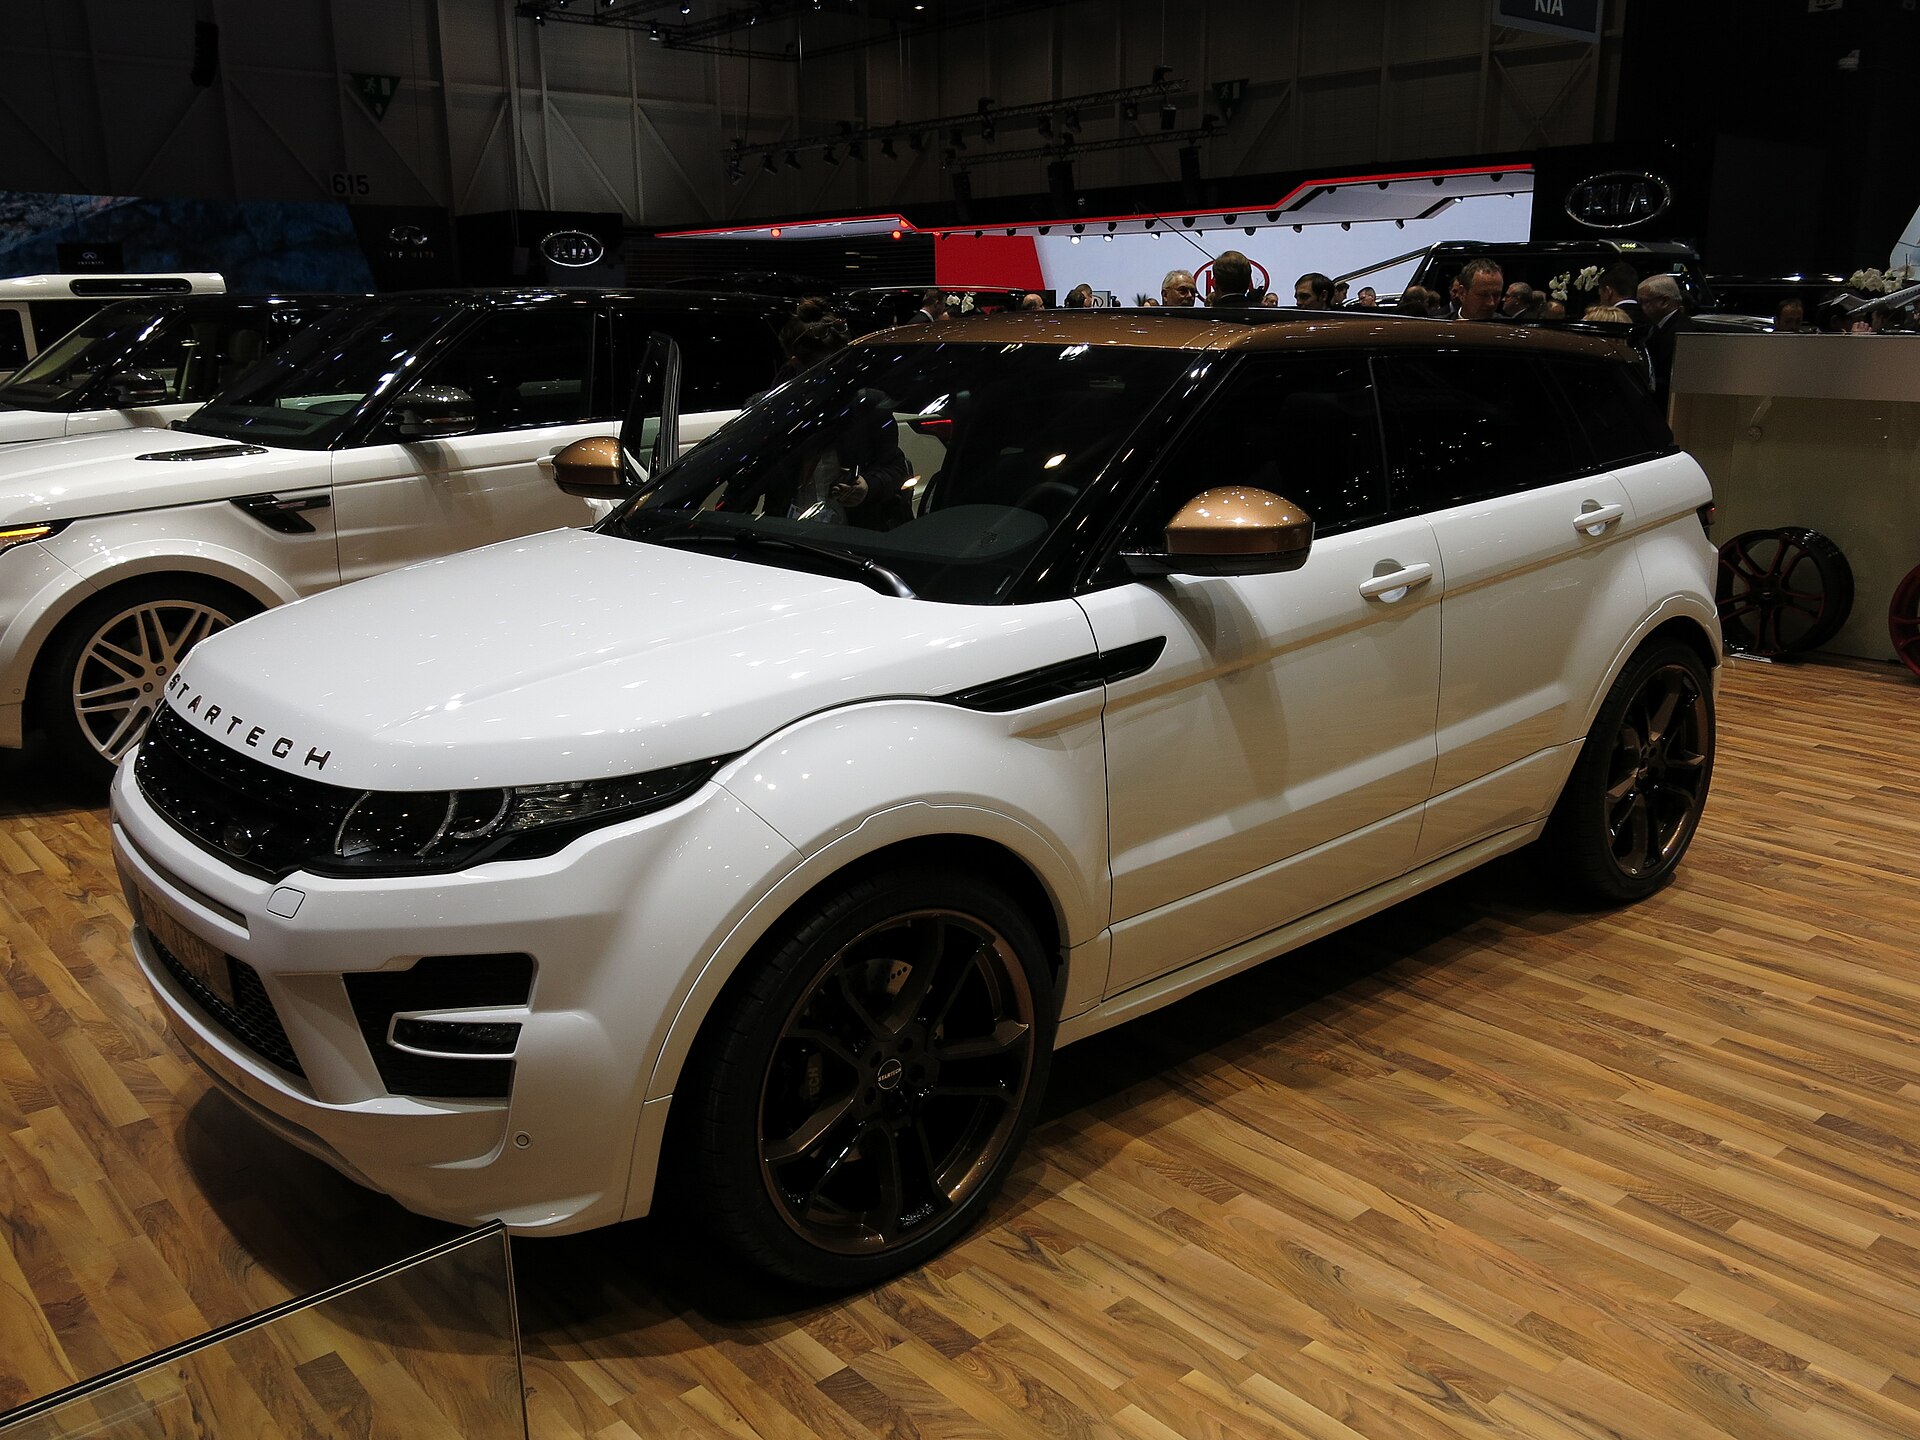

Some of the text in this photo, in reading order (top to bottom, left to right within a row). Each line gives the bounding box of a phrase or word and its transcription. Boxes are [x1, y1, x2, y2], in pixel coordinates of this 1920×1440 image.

[1534, 0, 1564, 16] KIA
[333, 174, 370, 194] 615
[1583, 184, 1653, 215] KIA
[549, 238, 595, 258] KIA
[169, 673, 332, 771] STARTECH
